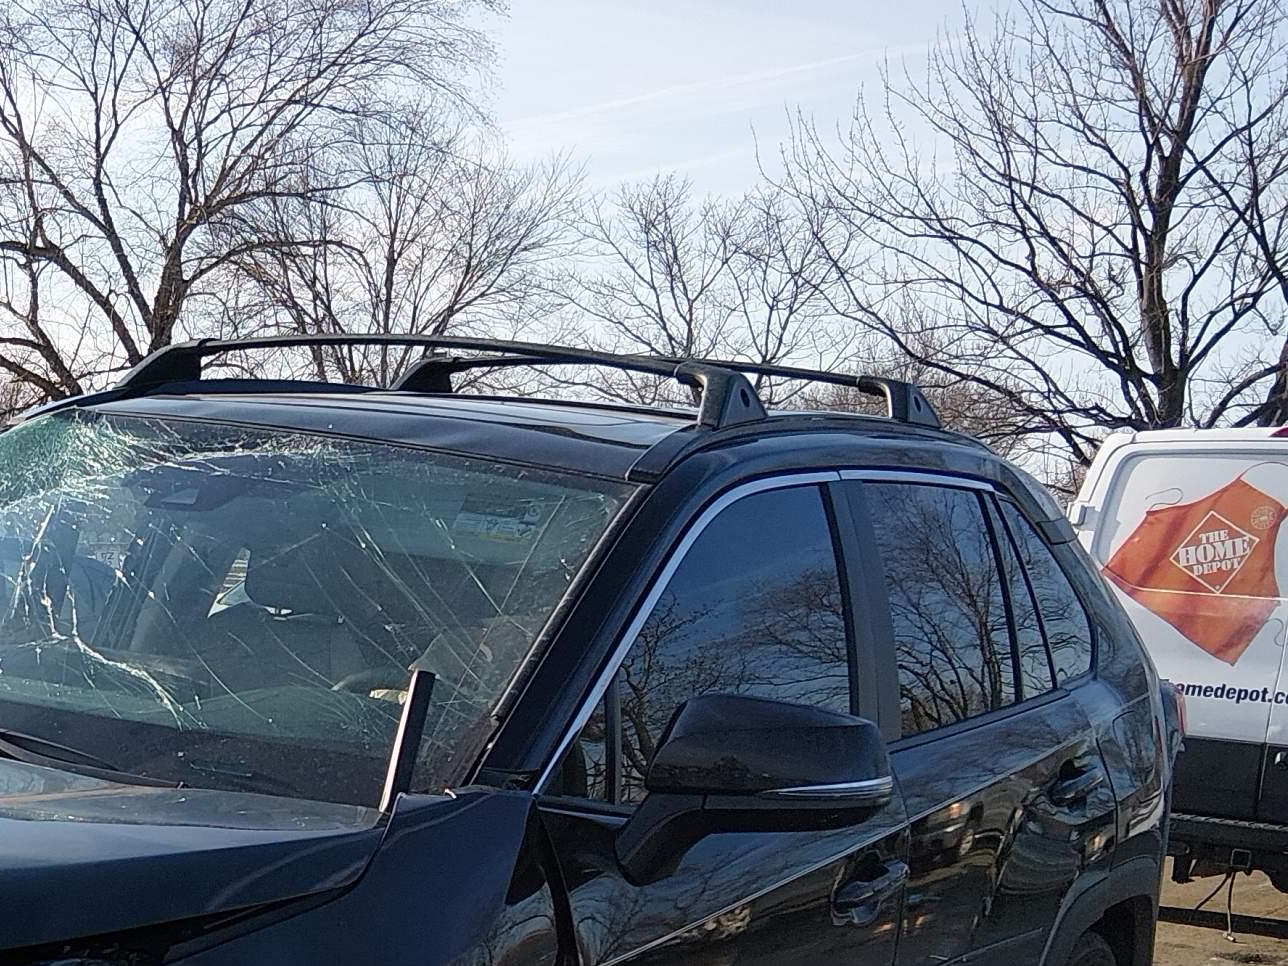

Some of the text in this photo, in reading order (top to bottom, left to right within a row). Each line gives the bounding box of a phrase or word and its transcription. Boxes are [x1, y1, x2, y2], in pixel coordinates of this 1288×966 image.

[1199, 529, 1229, 544] THE
[1178, 536, 1250, 567] HOME
[1193, 557, 1241, 576] DEPOT
[1175, 682, 1288, 705] omedepot.c
